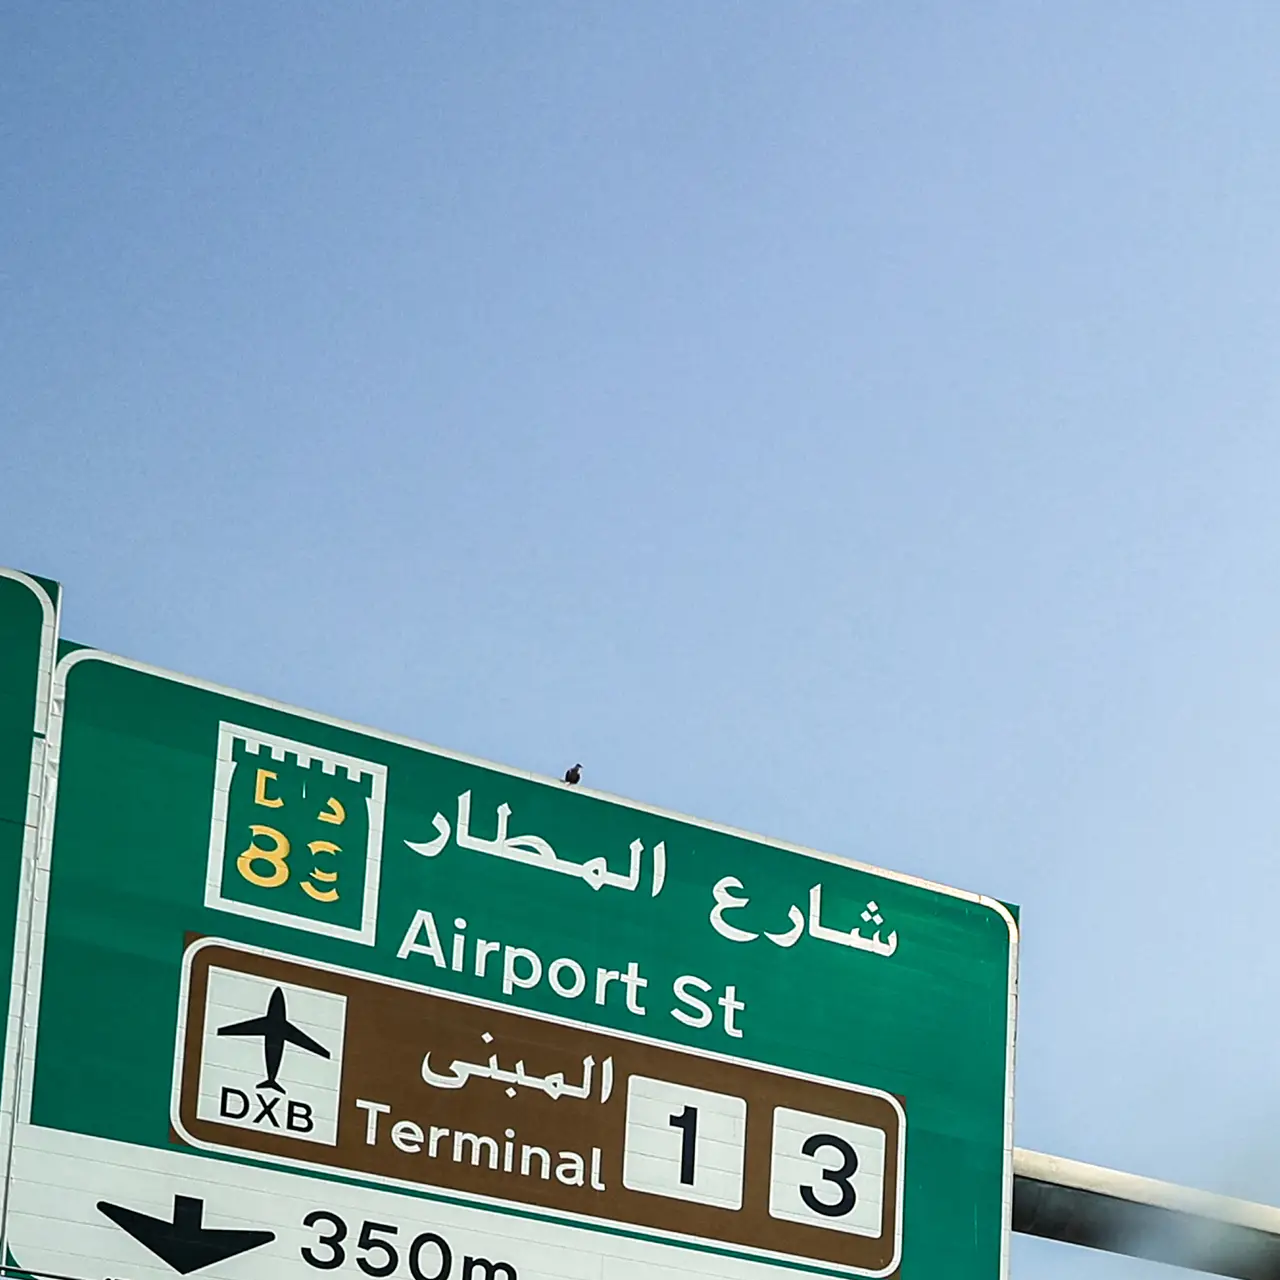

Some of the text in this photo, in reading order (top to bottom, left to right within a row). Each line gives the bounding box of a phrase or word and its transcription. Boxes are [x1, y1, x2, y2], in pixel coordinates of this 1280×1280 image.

[403, 789, 898, 958] شارع المطار
[396, 908, 746, 1038] Airport St
[219, 1086, 315, 1134] DXB
[421, 1031, 613, 1104] المبنى
[355, 1098, 607, 1192] Terminal
[669, 1105, 859, 1218] 1 3
